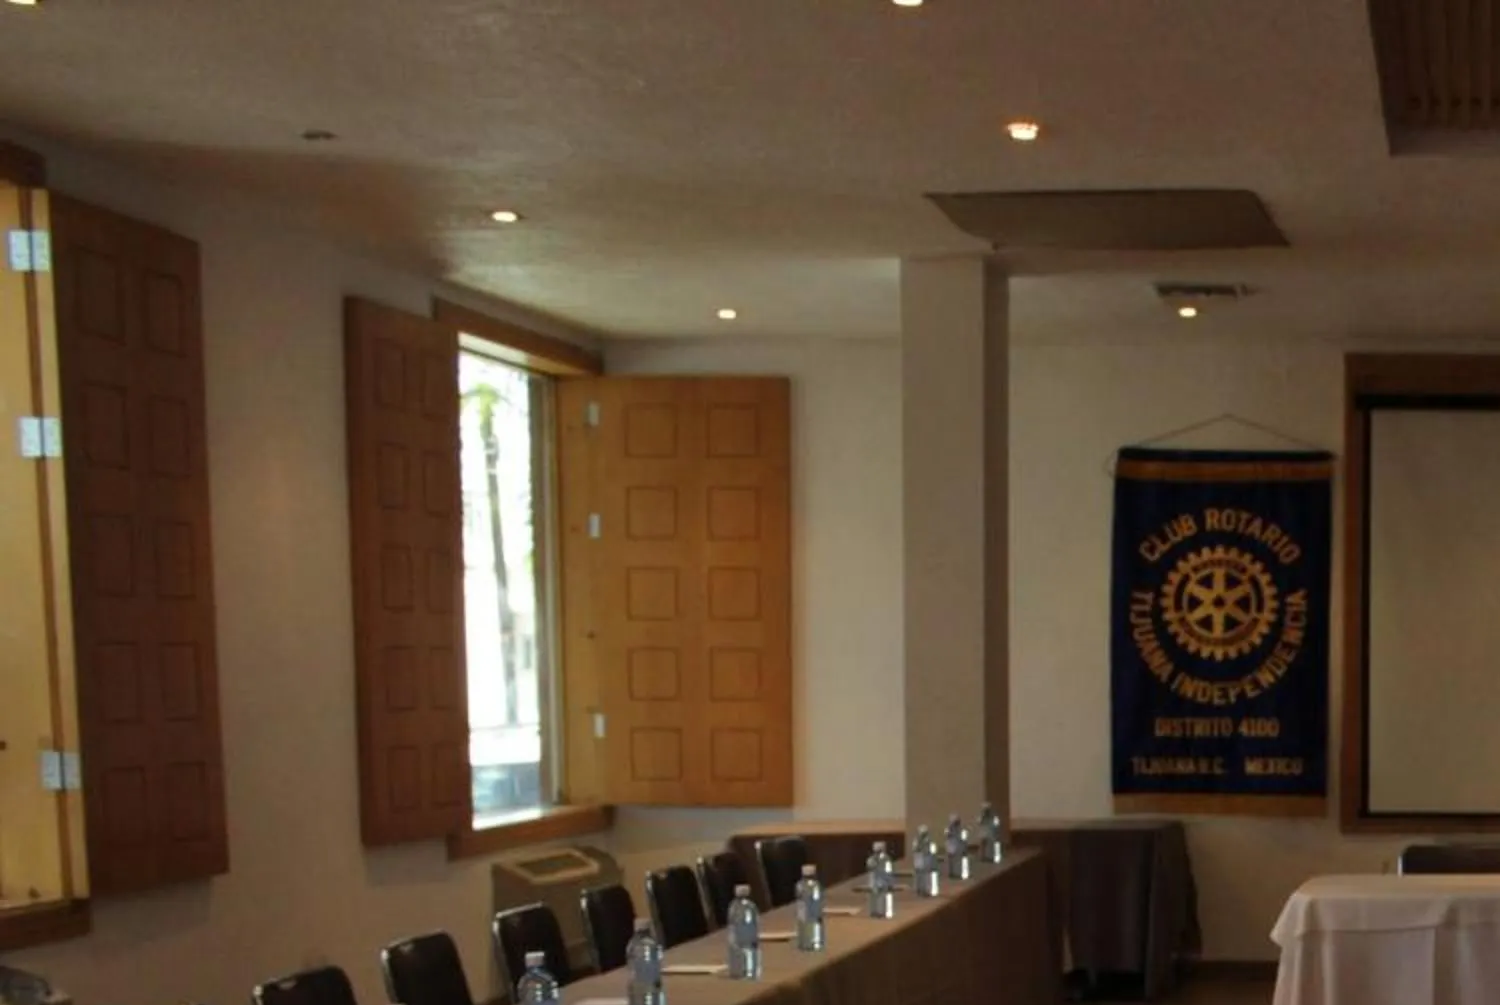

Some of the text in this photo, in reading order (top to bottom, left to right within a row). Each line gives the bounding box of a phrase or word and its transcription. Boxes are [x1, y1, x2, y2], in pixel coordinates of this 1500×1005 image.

[1139, 508, 1300, 564] CLUB ROTARIO
[1130, 590, 1174, 682] TIJUANA
[1154, 717, 1281, 737] DISTRITO 4100
